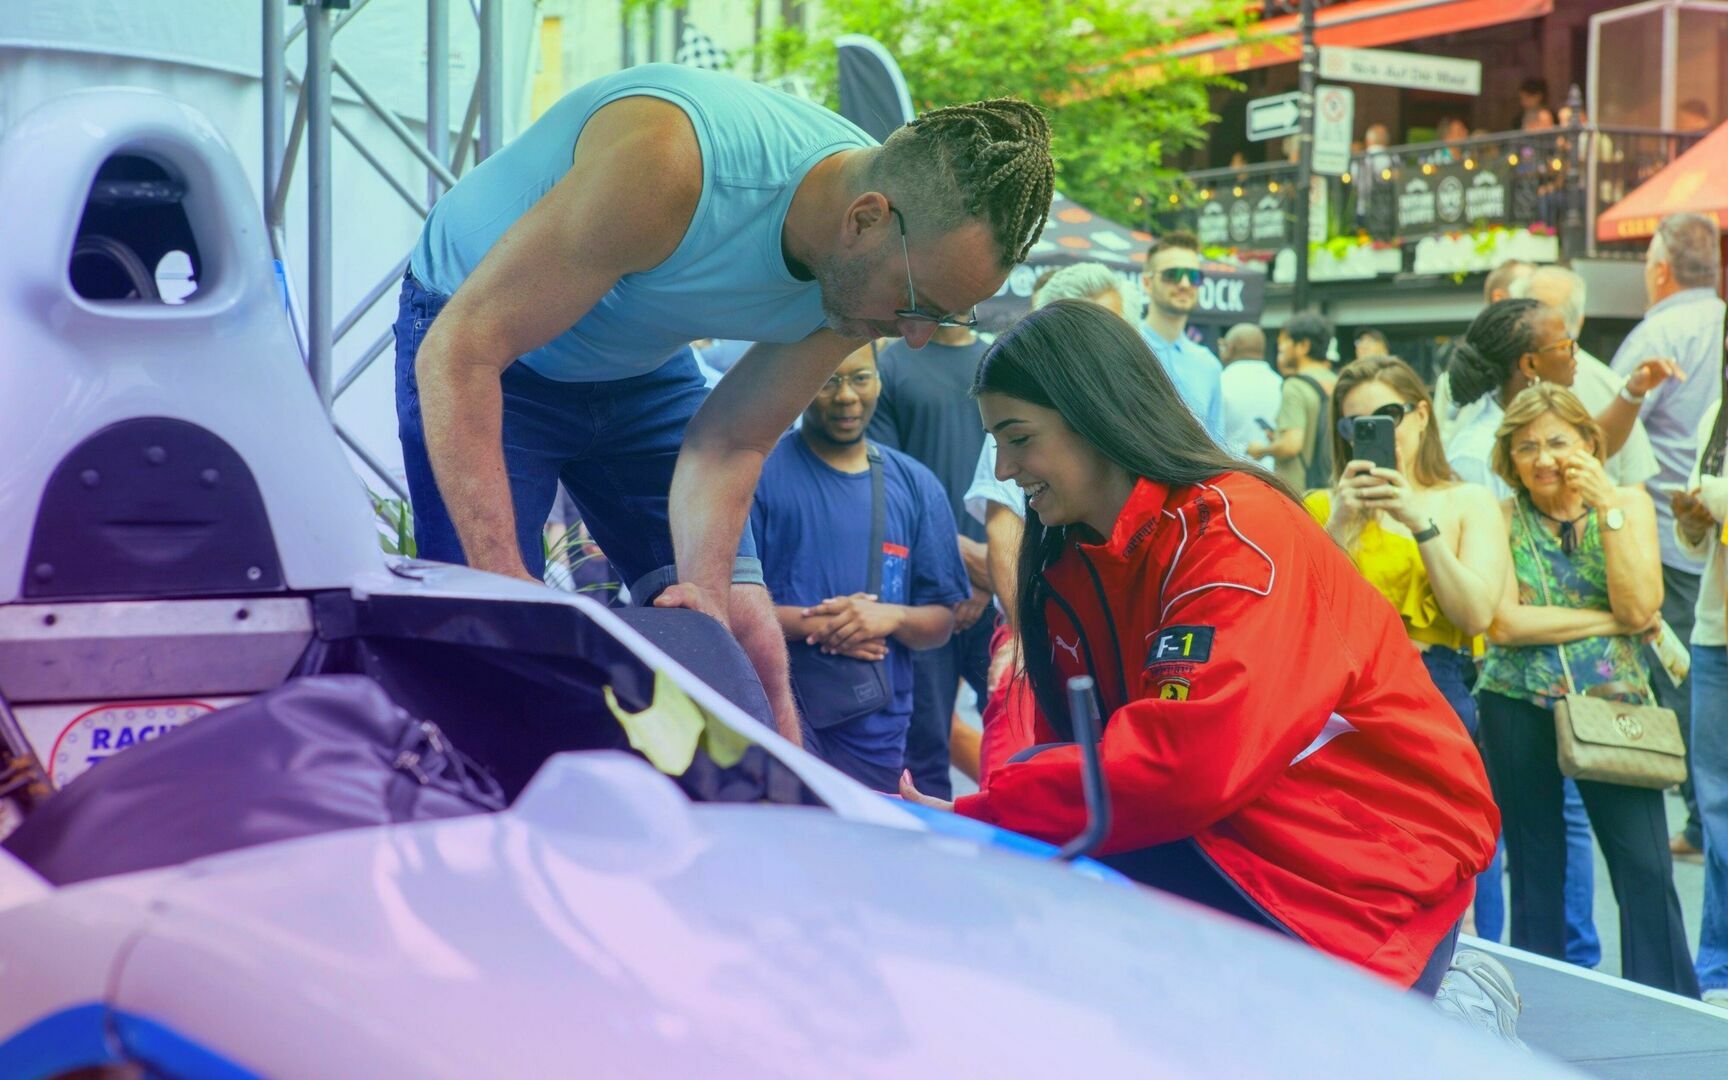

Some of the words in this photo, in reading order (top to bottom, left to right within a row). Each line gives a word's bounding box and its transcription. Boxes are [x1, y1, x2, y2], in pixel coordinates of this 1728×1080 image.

[1199, 277, 1244, 311] OCK
[1156, 633, 1193, 658] F-1
[92, 725, 177, 750] RAC
